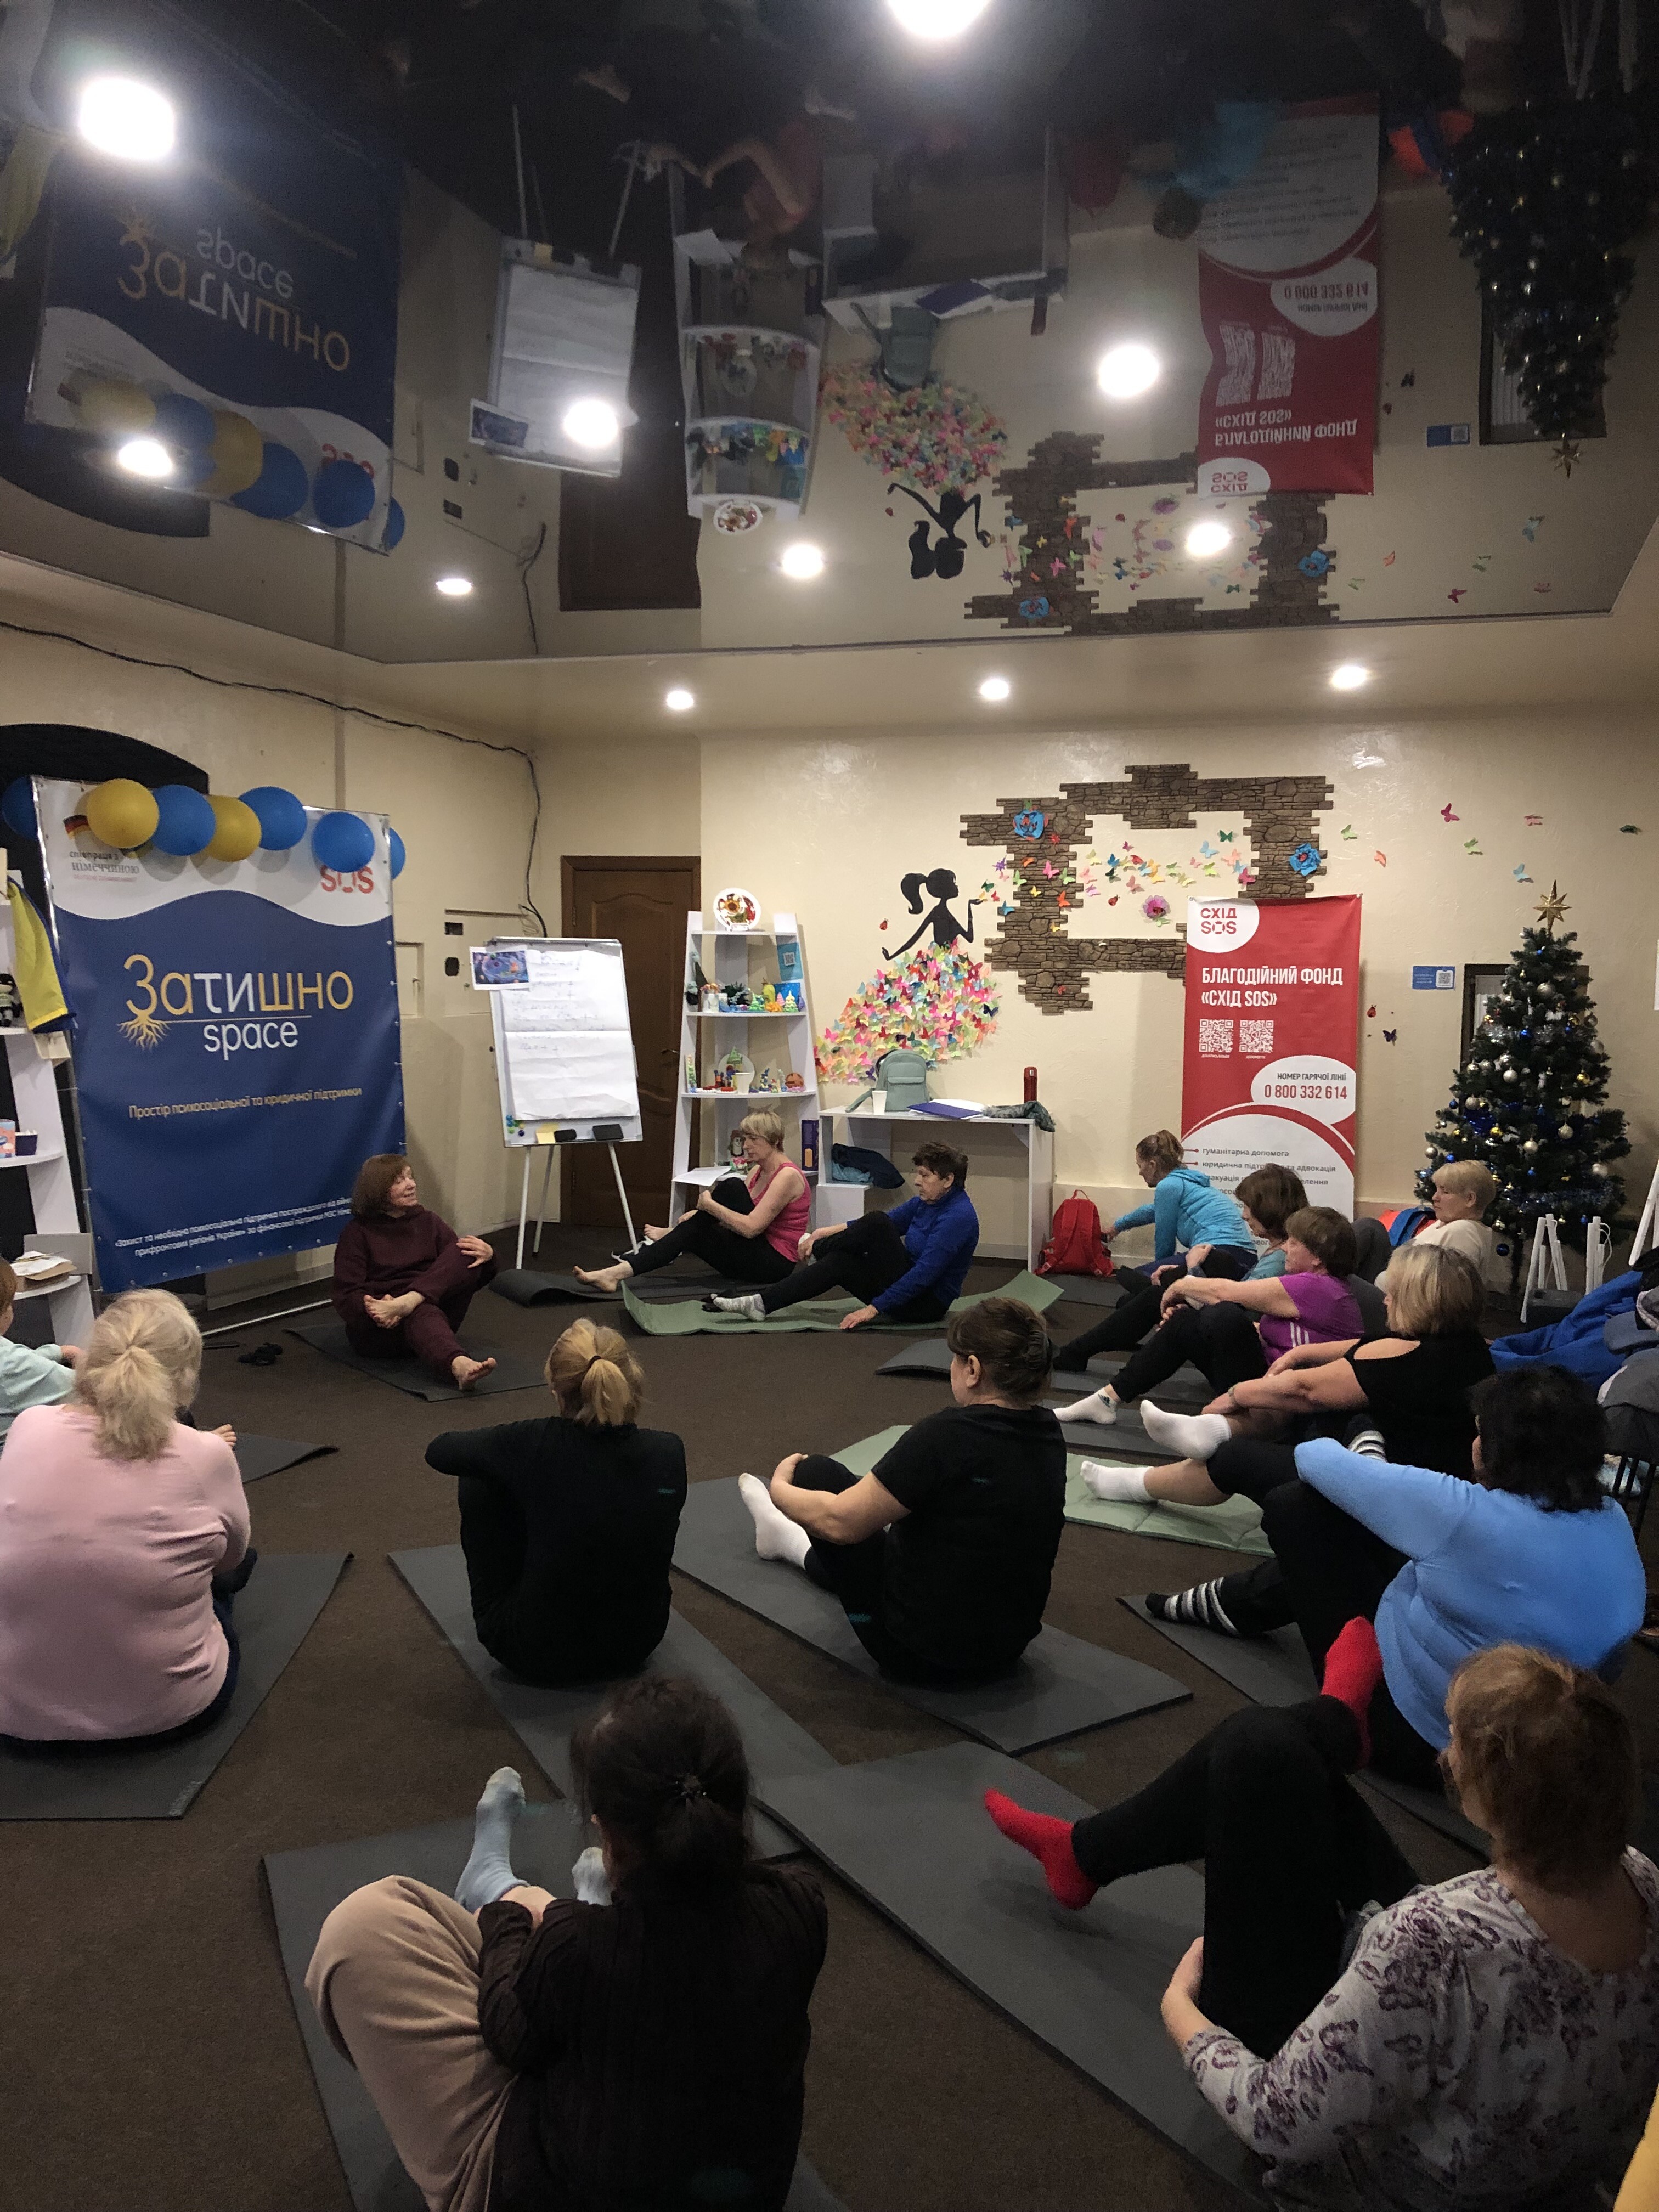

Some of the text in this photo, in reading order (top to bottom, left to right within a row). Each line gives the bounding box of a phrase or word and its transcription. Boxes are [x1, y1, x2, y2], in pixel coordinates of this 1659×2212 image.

[1200, 908, 1238, 919] СХІД
[1201, 921, 1237, 934] SOS
[123, 953, 354, 1015] Затишно
[1202, 966, 1343, 986] БЛАГОДІЙНИЙ ФОНД
[1201, 990, 1277, 1008] «СХІД SOS»
[204, 1021, 298, 1060] space
[1330, 1073, 1347, 1081] ЛІНІЇ
[1264, 1084, 1347, 1099] 0 800 332 614
[129, 1088, 362, 1120] Простір психосоціальної та юридичної підтримки
